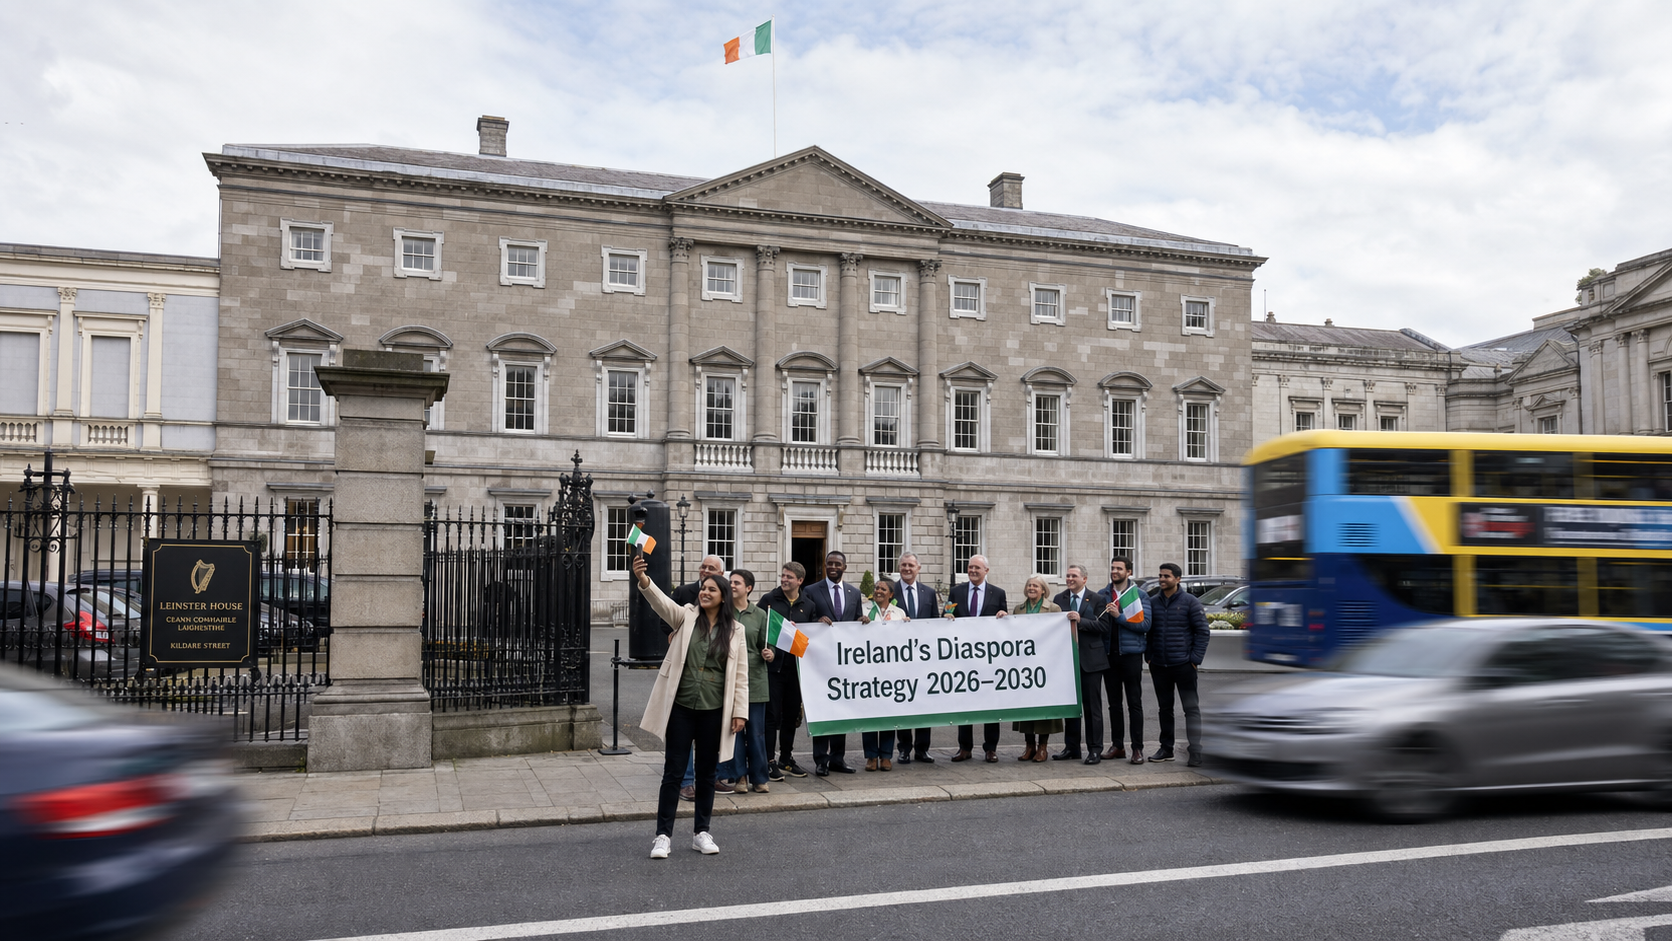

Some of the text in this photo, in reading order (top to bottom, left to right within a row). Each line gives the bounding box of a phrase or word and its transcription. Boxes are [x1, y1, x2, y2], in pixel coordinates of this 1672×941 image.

[160, 602, 243, 611] LEINSTER HOUSE
[837, 636, 1036, 665] Ireland’s Diaspora
[827, 666, 1047, 703] Strategy 2026–2030
